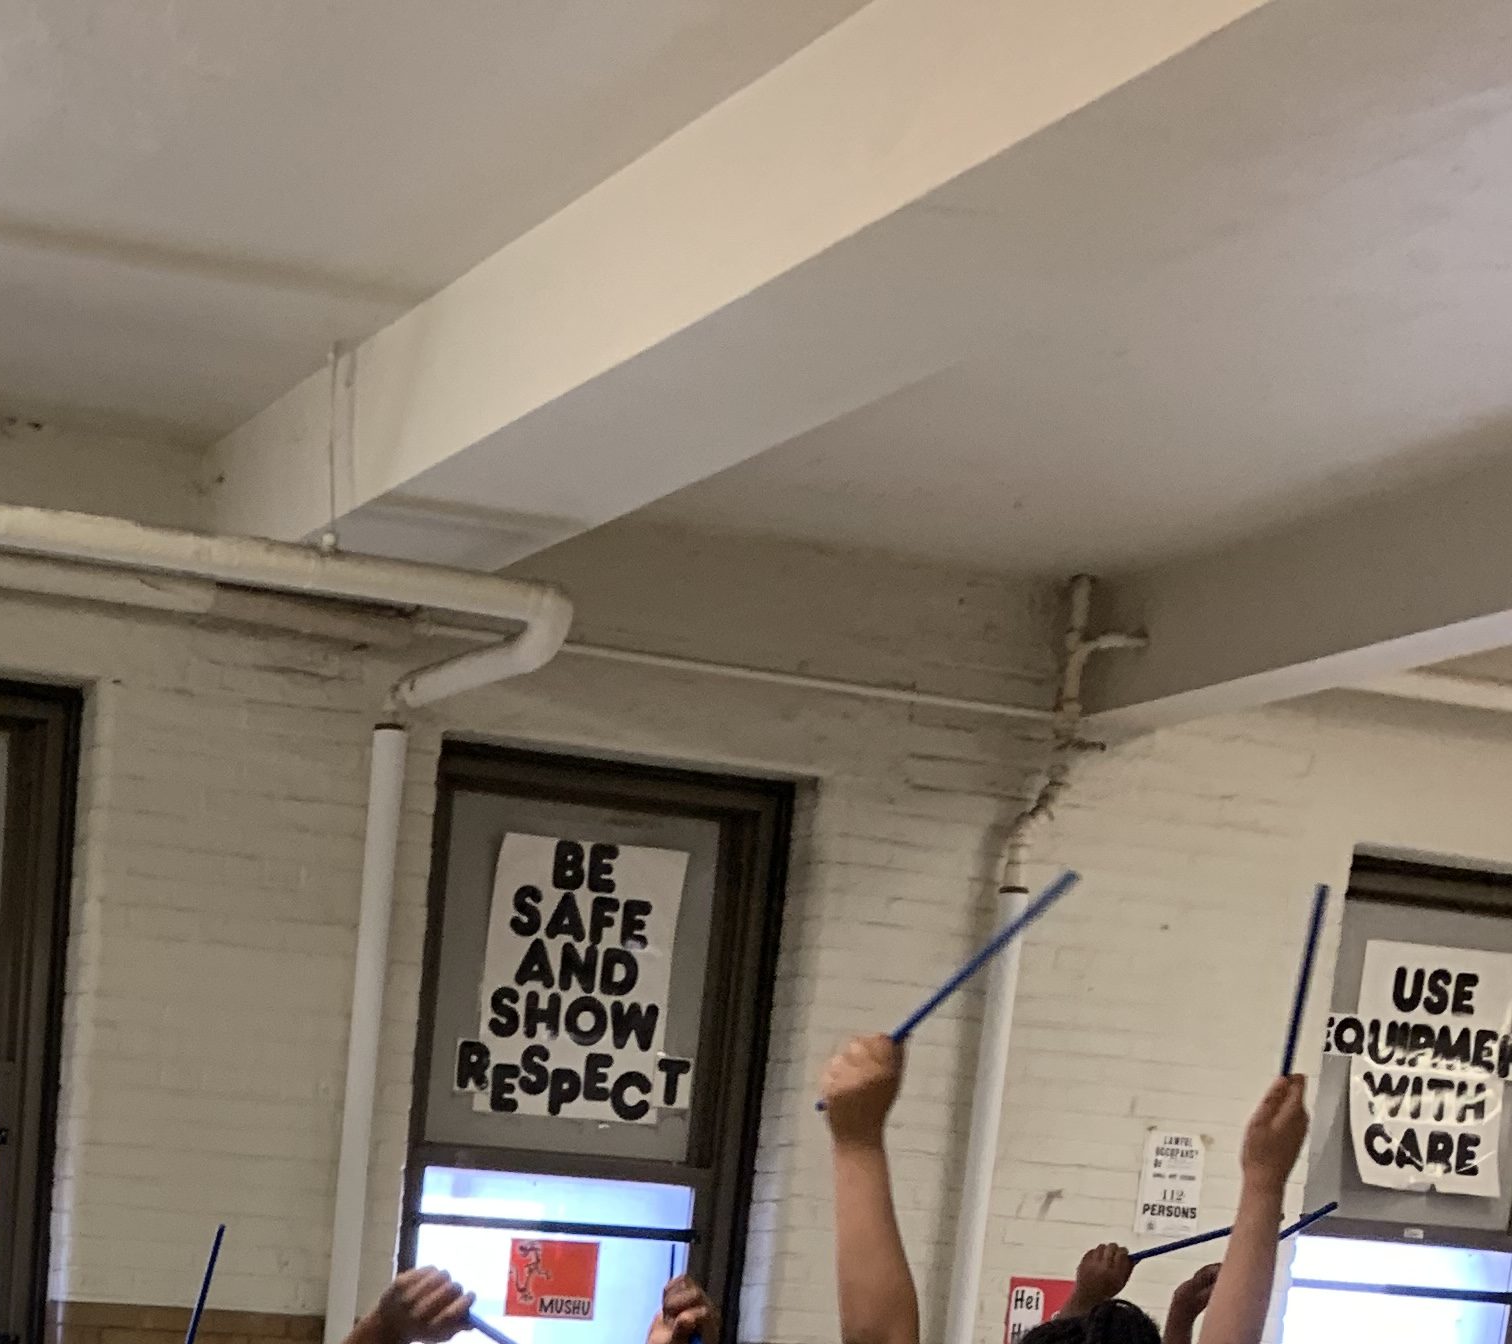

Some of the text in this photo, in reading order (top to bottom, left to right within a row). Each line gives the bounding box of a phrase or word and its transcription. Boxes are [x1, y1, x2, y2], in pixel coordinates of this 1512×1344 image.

[552, 840, 620, 893] BE
[509, 885, 653, 951] SAFE
[514, 938, 639, 996] AND
[1392, 966, 1480, 1017] USE
[488, 986, 660, 1052] SHOW
[455, 1040, 691, 1121] RESPECT
[1363, 1071, 1487, 1123] WITH
[1364, 1122, 1481, 1177] CARE
[1142, 1203, 1197, 1219] PERSONS
[538, 1297, 591, 1316] MUSHU
[1013, 1289, 1040, 1310] Hei
